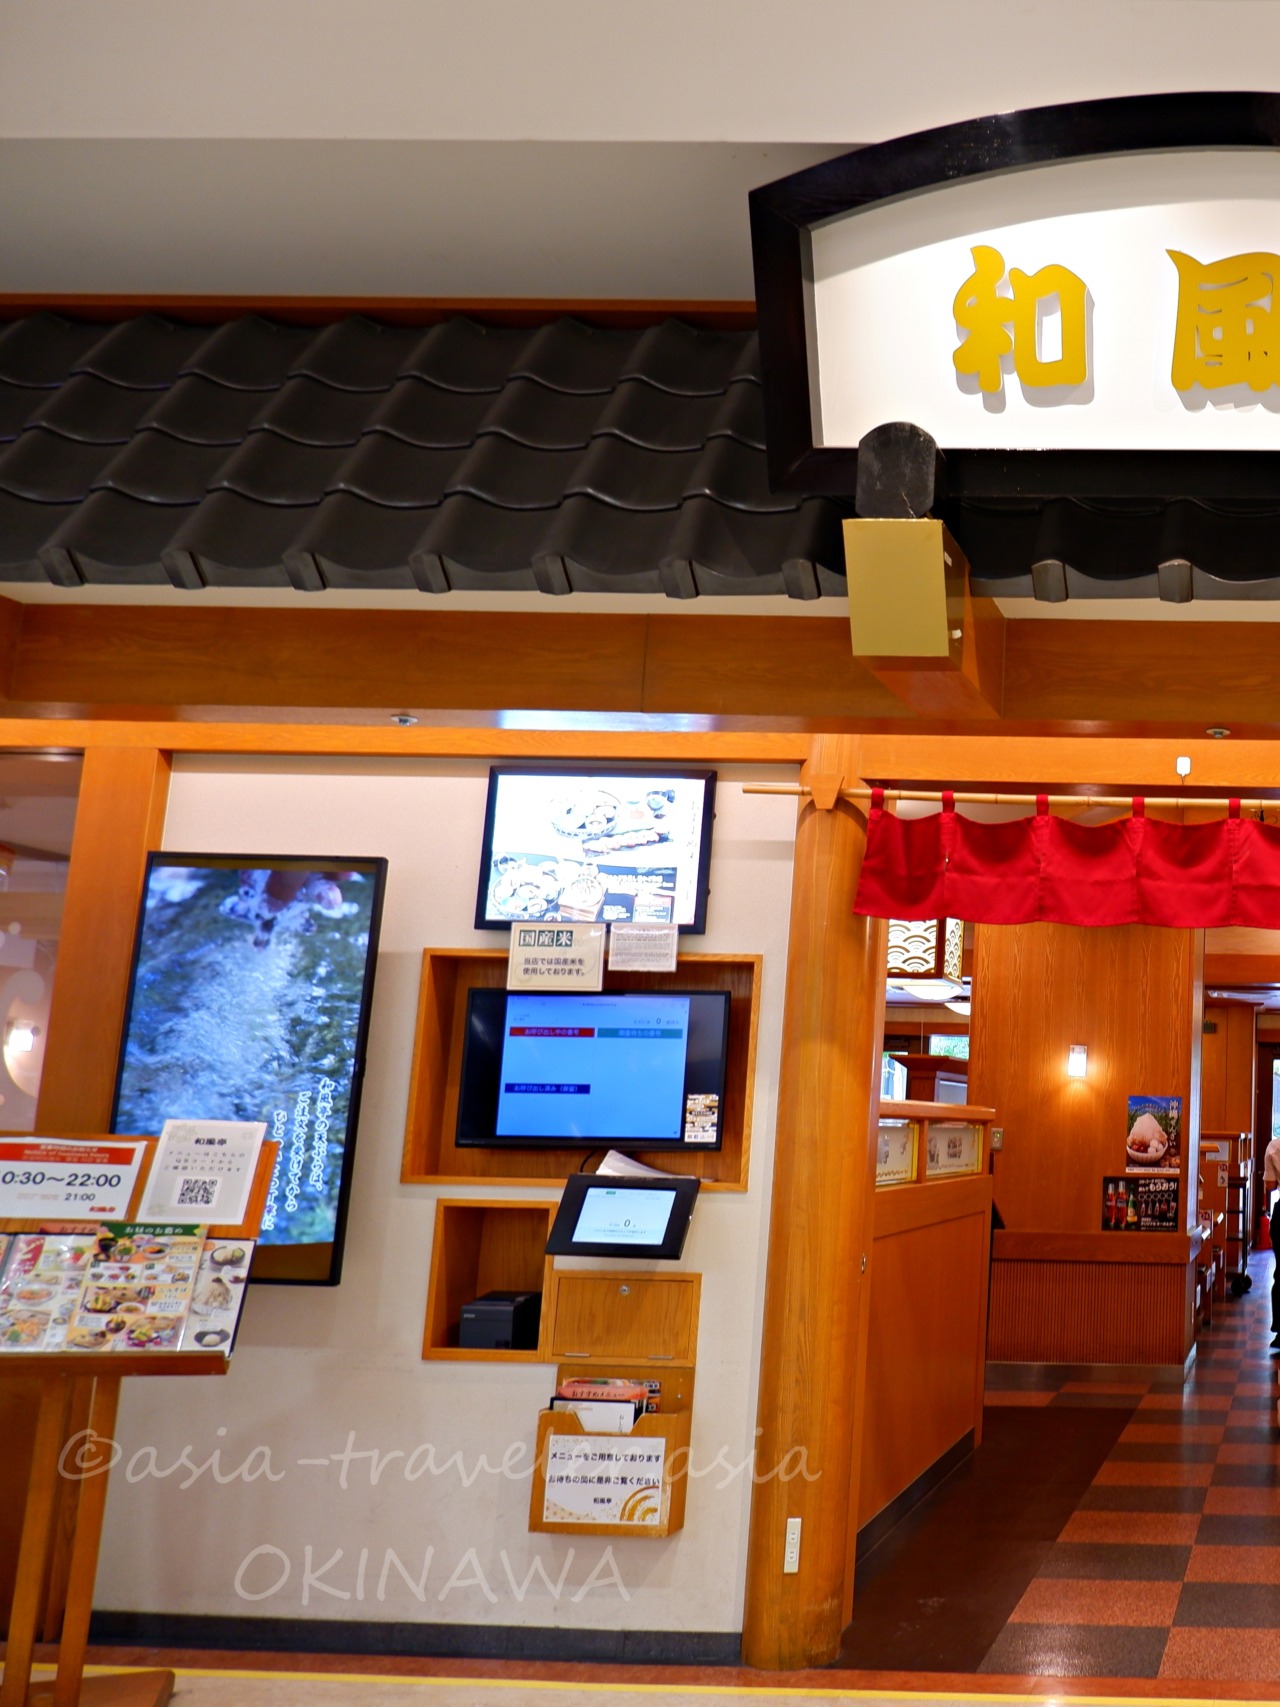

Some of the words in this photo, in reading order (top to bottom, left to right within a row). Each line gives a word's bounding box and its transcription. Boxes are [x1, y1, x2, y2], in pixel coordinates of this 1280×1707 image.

[519, 930, 573, 947] 国産米
[524, 957, 585, 966] 当店では国産米を
[523, 967, 586, 976] 使用しております。
[64, 1192, 96, 1201] 21:00
[551, 1452, 661, 1462] メニューをご用意しております
[549, 1475, 660, 1486] お待ちの間に是非ご覧ください
